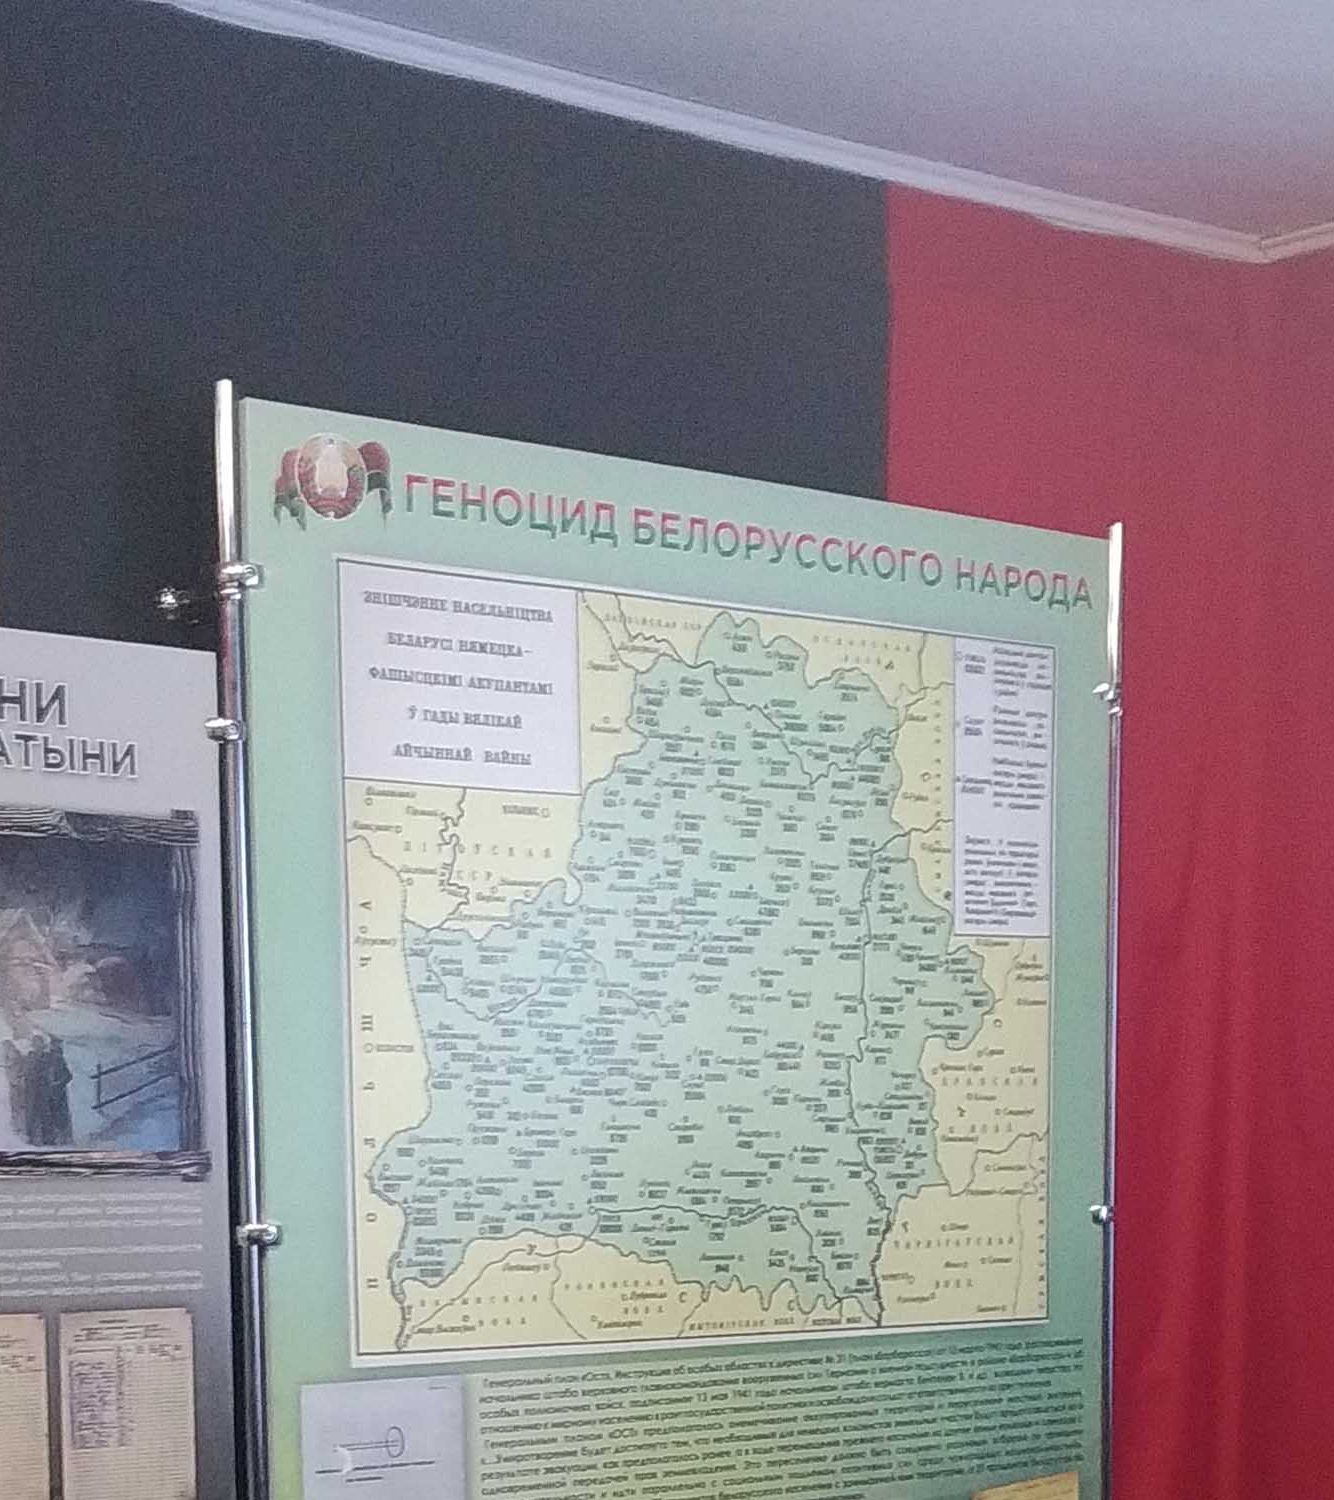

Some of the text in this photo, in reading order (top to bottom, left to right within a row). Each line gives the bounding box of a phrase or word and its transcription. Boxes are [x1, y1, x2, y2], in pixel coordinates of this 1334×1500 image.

[404, 473, 1094, 614] ГЕНОЦИД БЕЛОРУССКОГО НАРОДА
[452, 599, 553, 623] НАСЕЛЬНІЦТВА
[387, 632, 453, 651] БЕЛАРУСІ
[369, 666, 553, 696] ФАШЫСЦКІМІ АКУПАНТАМІ
[408, 705, 522, 730] Ў ГАДЫ ВЯЛІКАЙ
[393, 742, 532, 766] АЙЧЫННАЙ ВАЙНЫ
